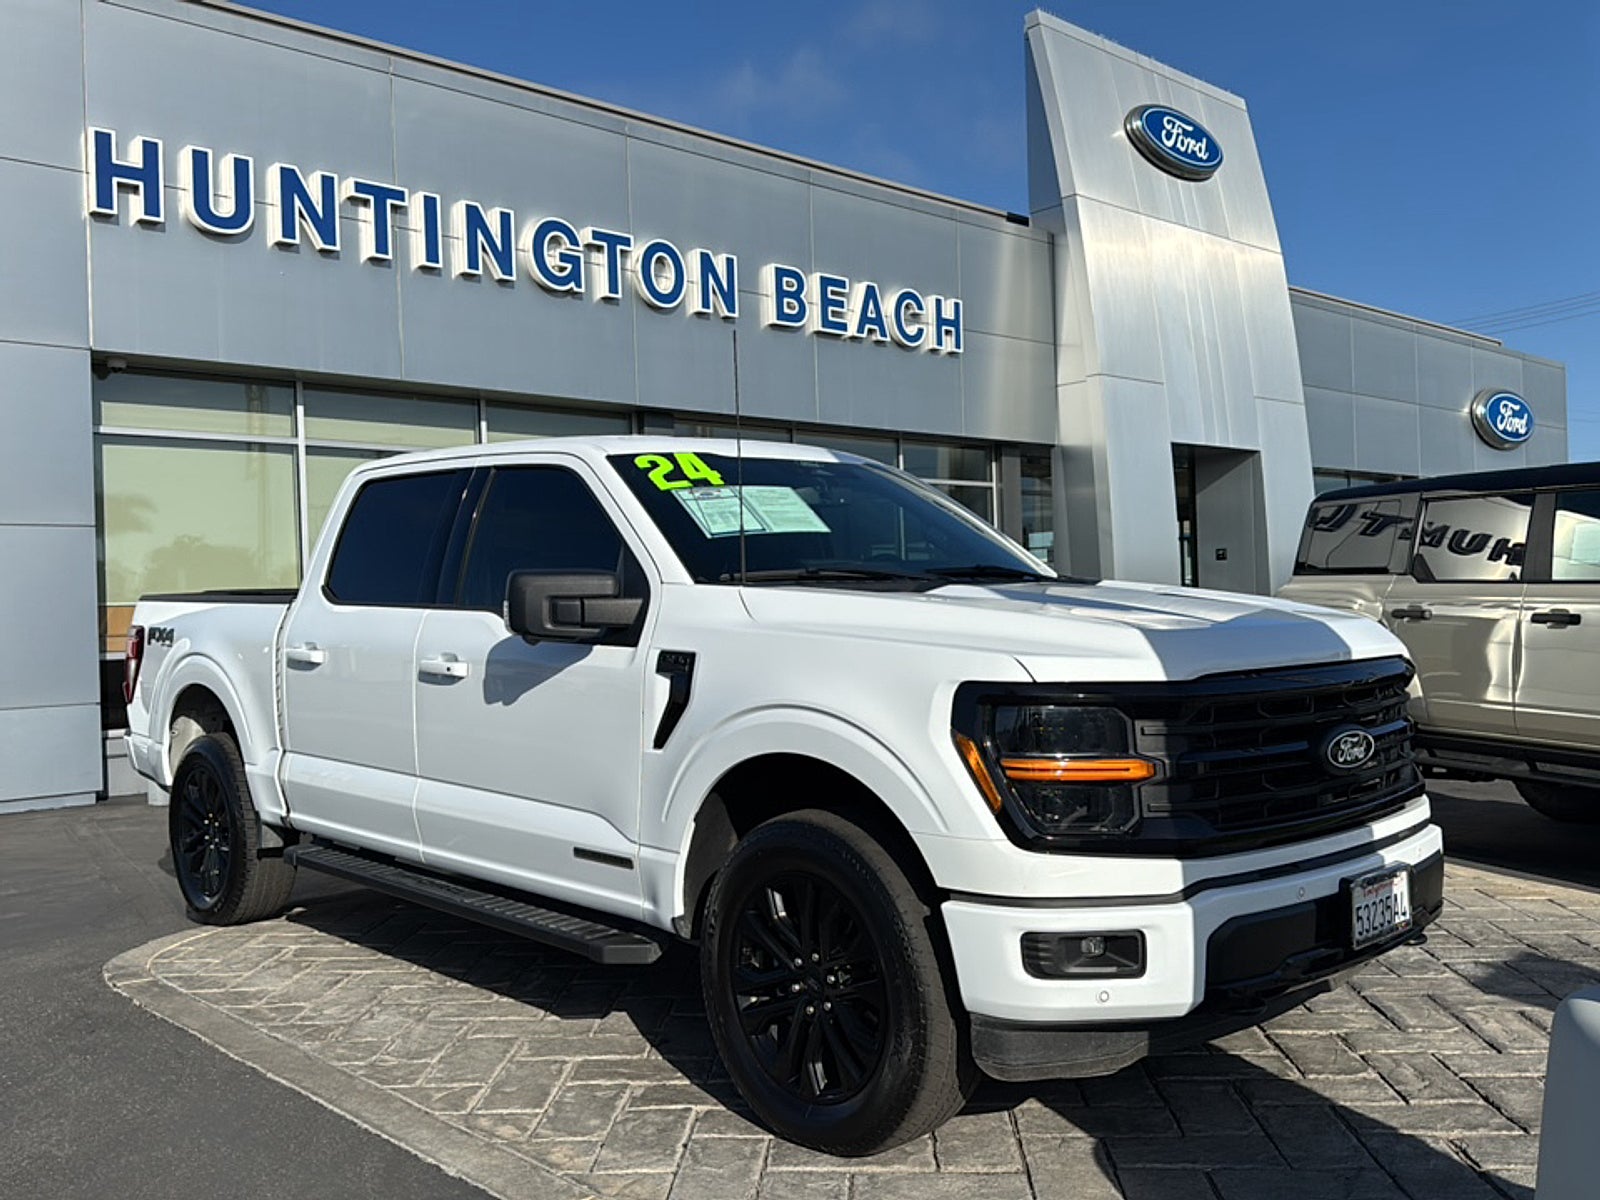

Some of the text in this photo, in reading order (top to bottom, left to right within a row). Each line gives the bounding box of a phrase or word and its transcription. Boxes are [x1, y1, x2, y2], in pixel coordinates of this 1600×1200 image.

[1161, 115, 1209, 160] Ford
[88, 127, 964, 354] HUNTINGTON BEACH
[1496, 400, 1528, 435] Ford
[633, 452, 725, 491] 24
[147, 626, 175, 646] FX4
[1338, 736, 1367, 763] Ford
[1355, 892, 1407, 937] 53235A4
